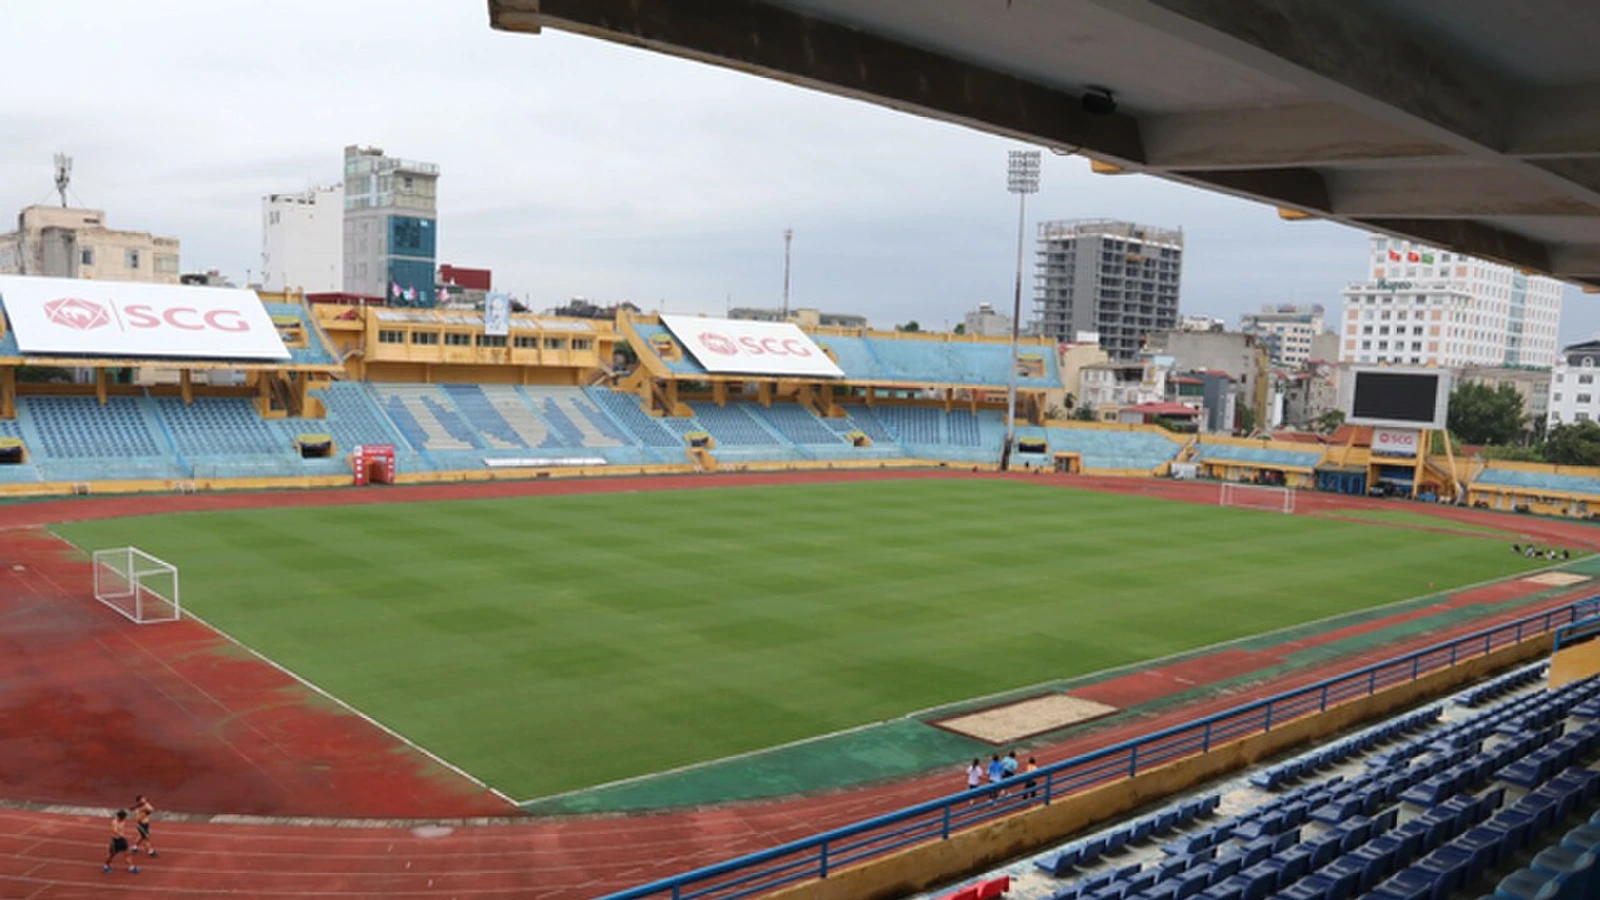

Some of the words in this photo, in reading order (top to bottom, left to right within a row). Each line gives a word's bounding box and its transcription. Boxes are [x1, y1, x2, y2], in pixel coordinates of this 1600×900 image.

[123, 304, 250, 332] SCG
[739, 336, 812, 357] SCG
[1390, 433, 1413, 445] SCG
